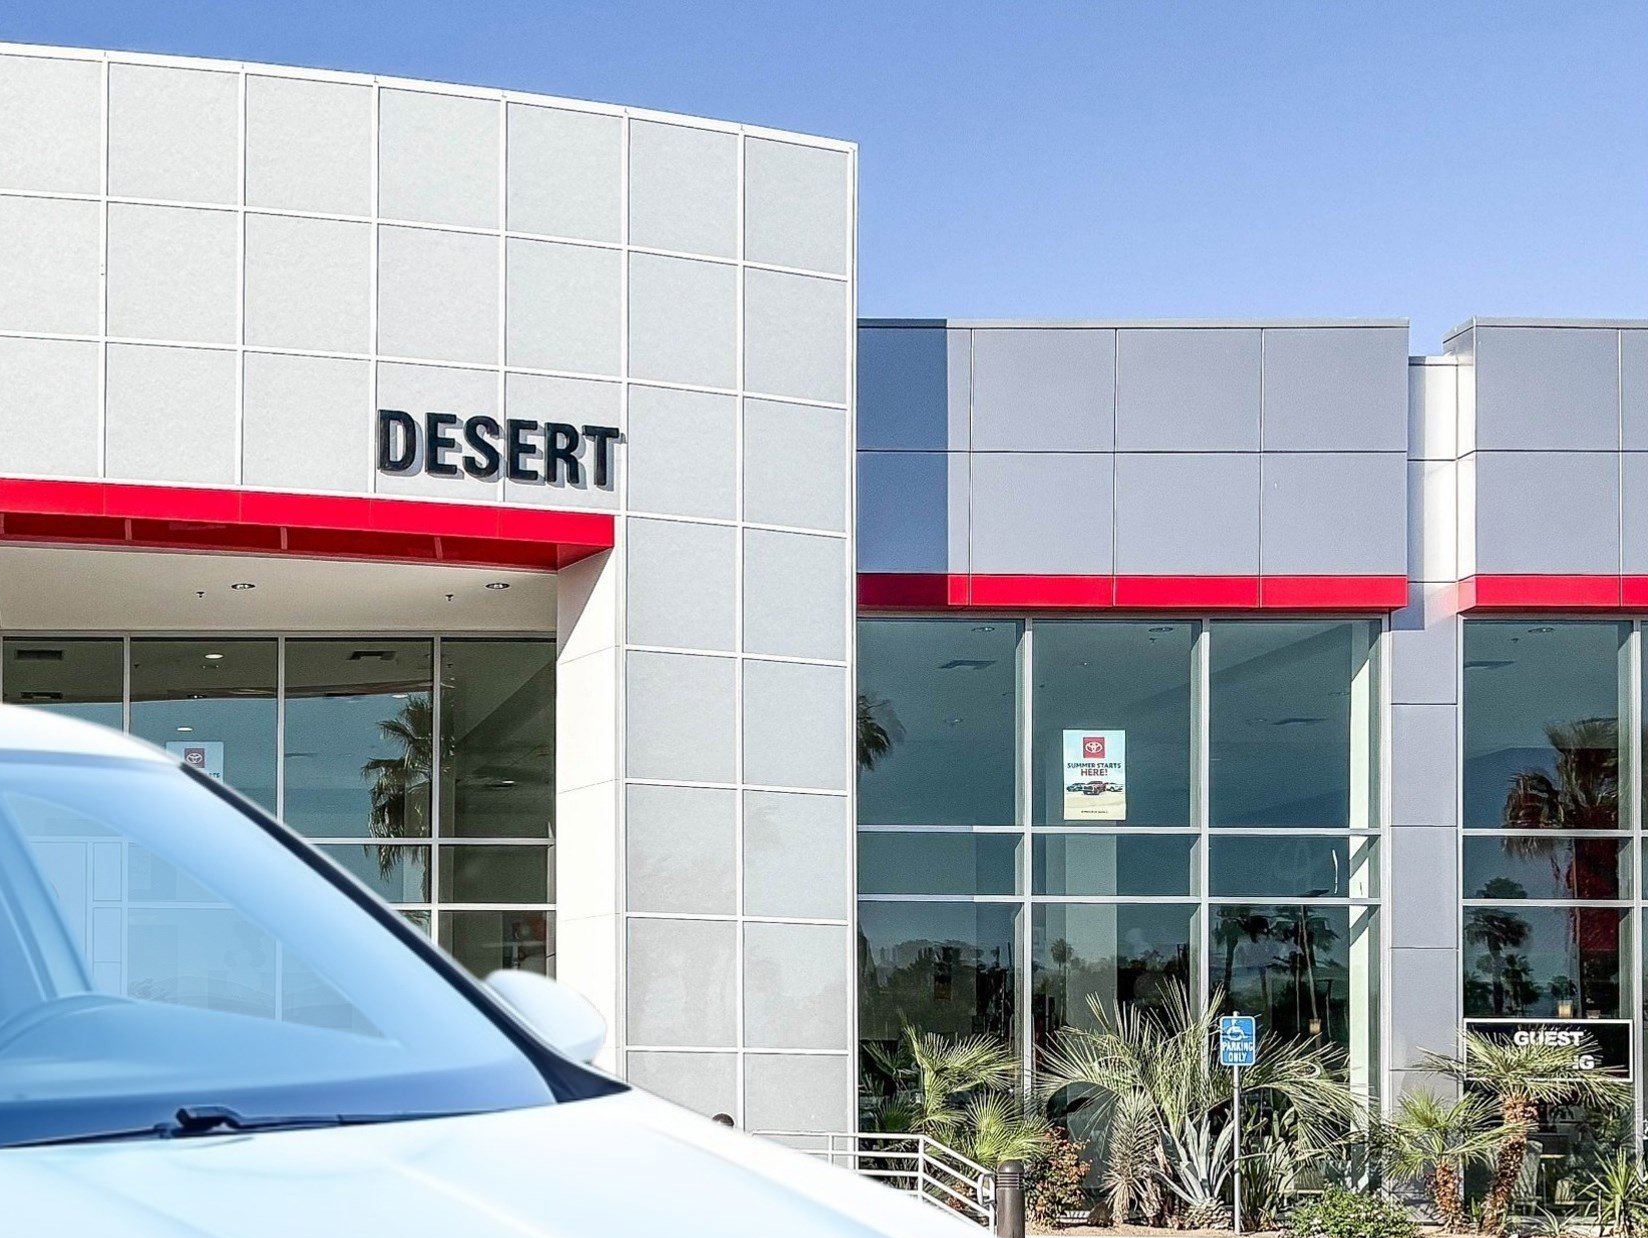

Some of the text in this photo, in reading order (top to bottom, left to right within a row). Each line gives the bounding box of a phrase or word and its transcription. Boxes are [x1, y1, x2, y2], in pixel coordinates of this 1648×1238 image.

[377, 409, 620, 487] DESERT
[1080, 768, 1108, 777] HERE!
[1513, 1030, 1584, 1047] GUEST
[1222, 1041, 1253, 1052] PARKING
[1228, 1052, 1248, 1062] ONLY
